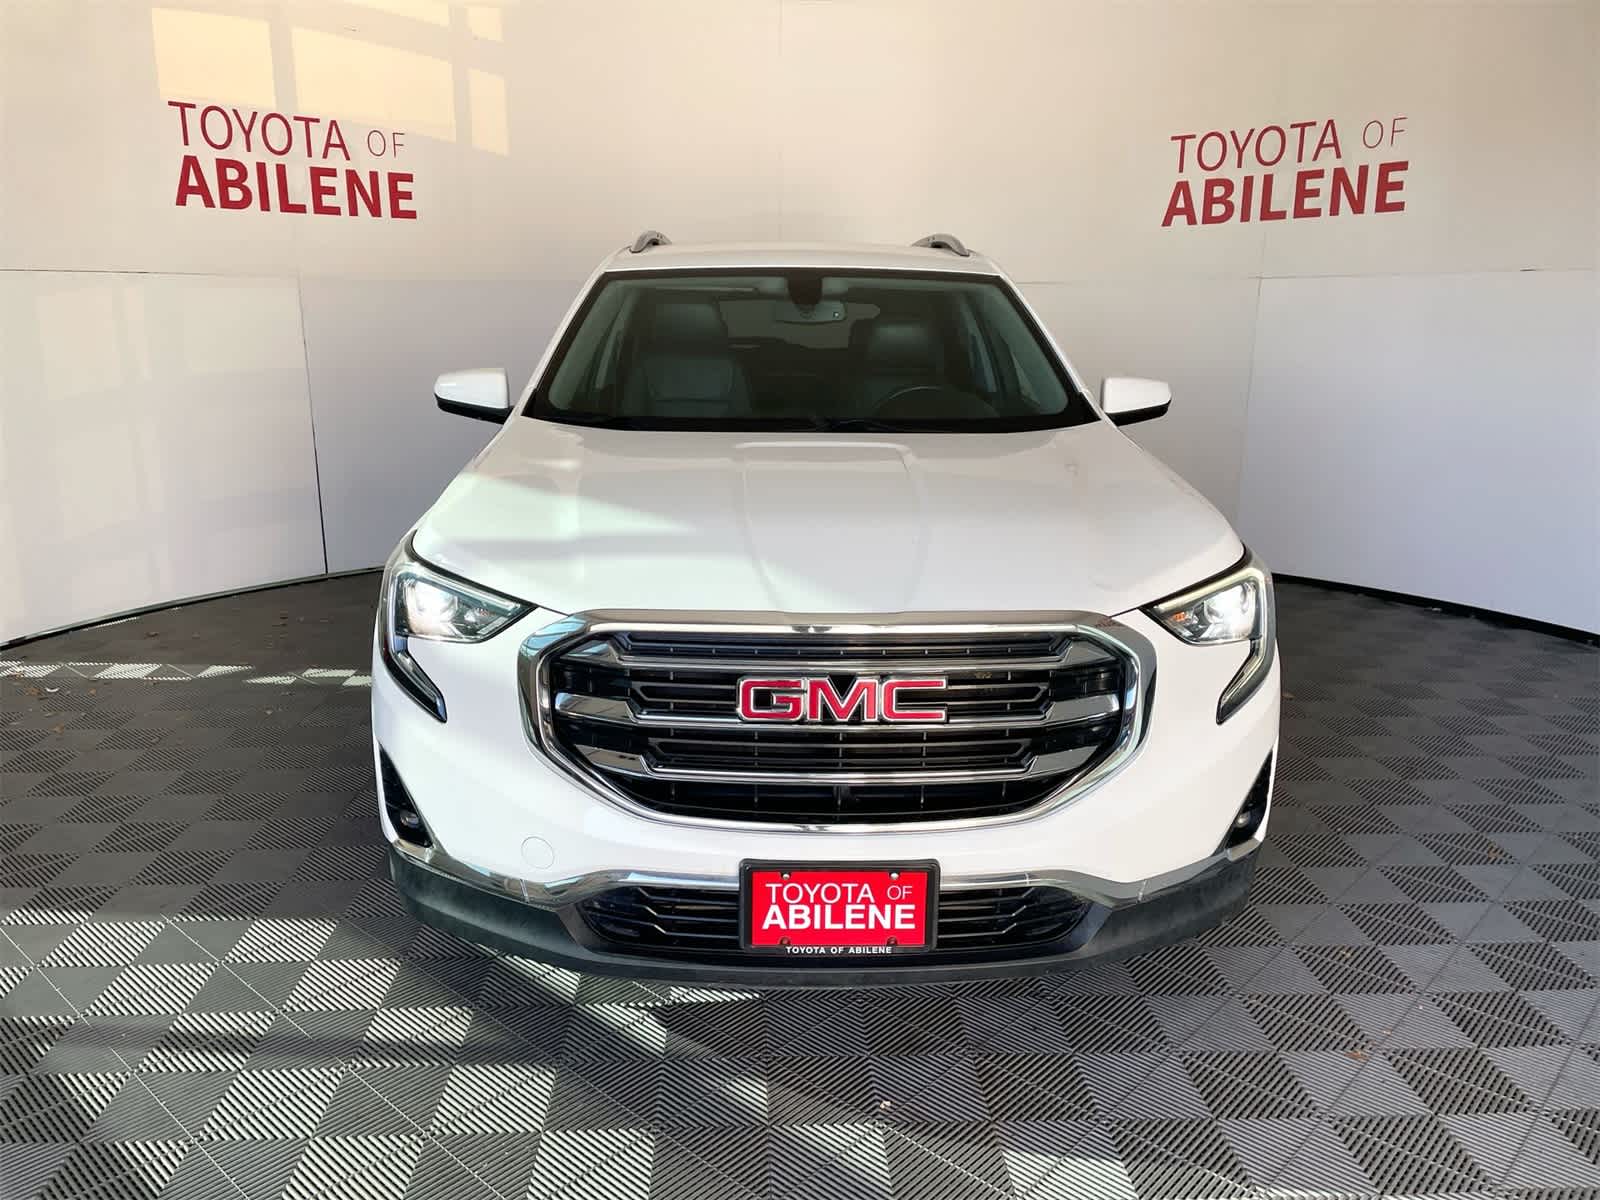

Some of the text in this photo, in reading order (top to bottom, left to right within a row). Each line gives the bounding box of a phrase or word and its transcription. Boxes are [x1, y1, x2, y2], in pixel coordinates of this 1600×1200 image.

[168, 100, 406, 161] TOYOTA OF
[1171, 116, 1409, 174] TOYOTA OF
[175, 155, 418, 220] ABILENE
[1162, 160, 1409, 227] ABILENE
[736, 675, 949, 724] GMC
[761, 904, 916, 930] ABILENE
[765, 882, 913, 904] TOYOTA OF
[786, 946, 892, 954] TOYOTA OF ABILENE
